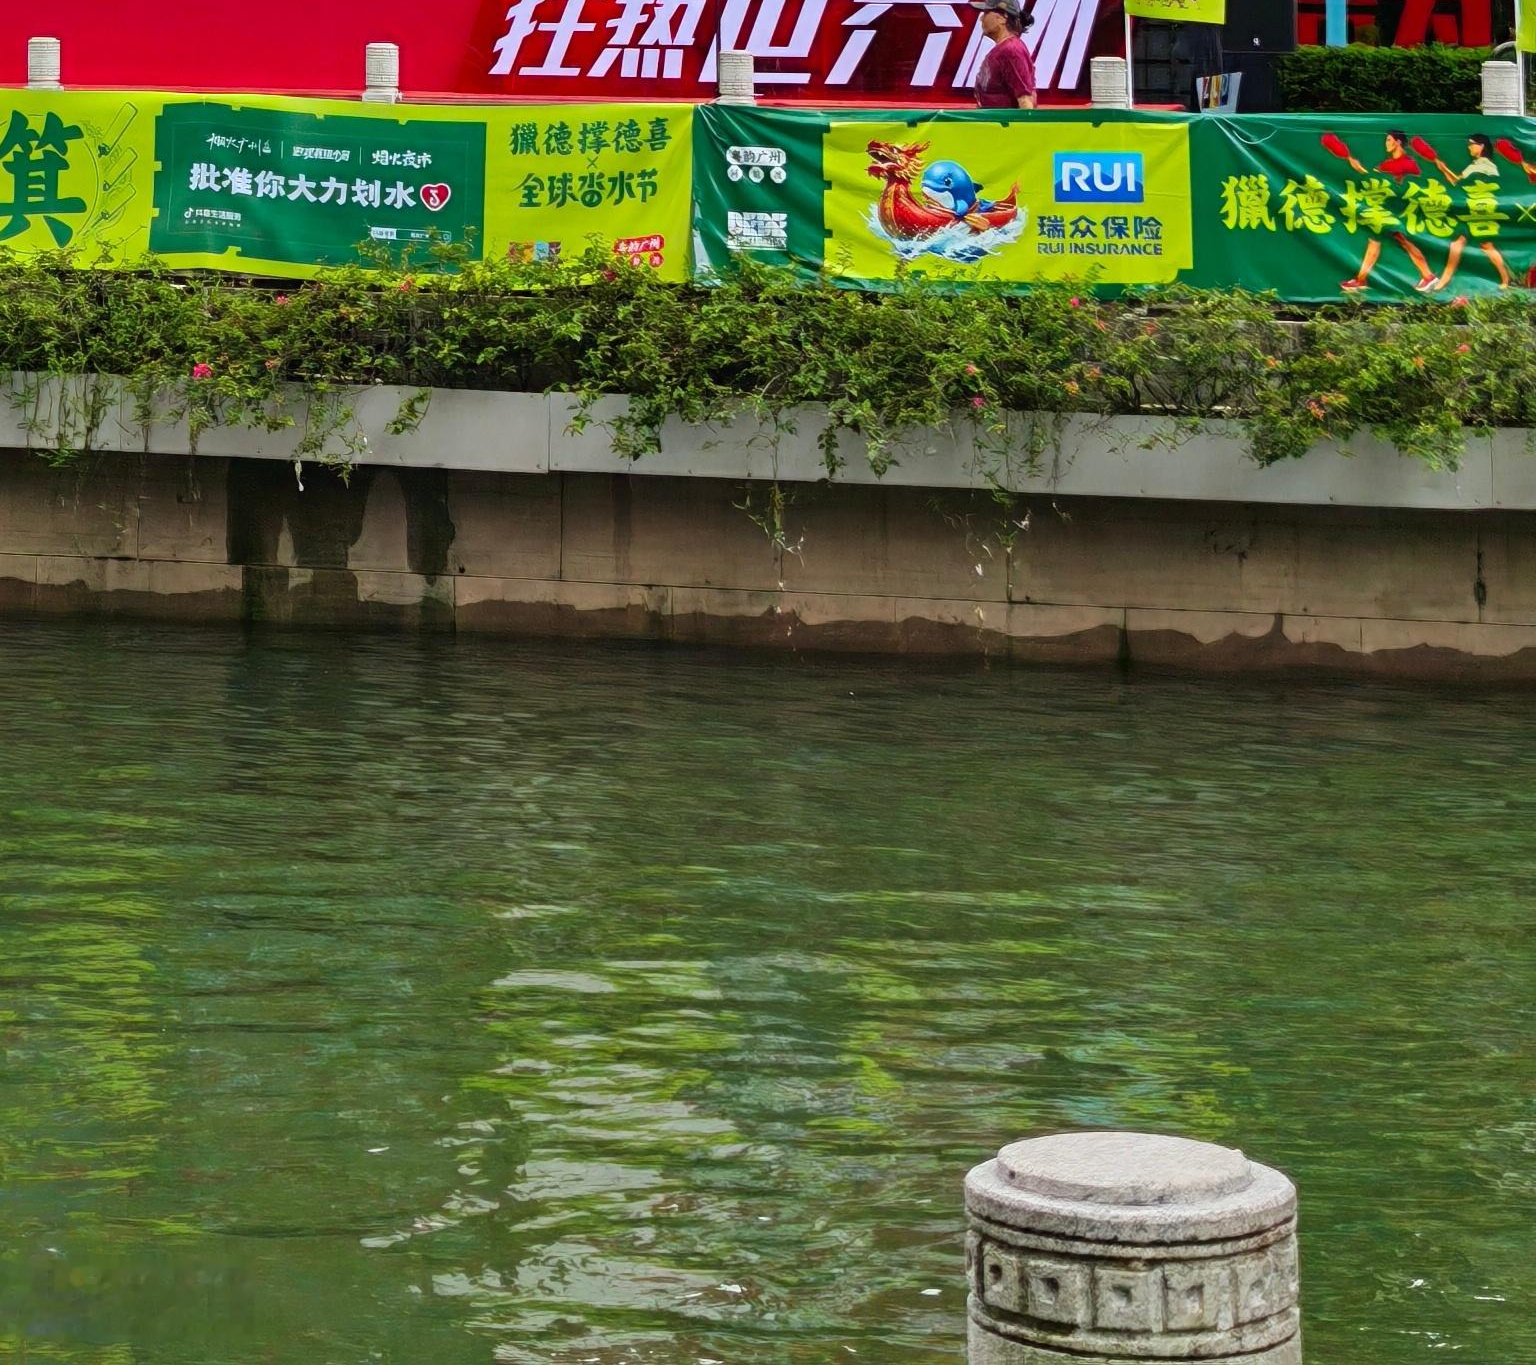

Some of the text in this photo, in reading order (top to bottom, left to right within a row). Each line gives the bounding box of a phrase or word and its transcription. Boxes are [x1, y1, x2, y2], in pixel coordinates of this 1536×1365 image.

[189, 163, 417, 209] 批准你大力划水
[1061, 161, 1136, 192] RUI
[1037, 215, 1163, 240] 瑞众保险
[1037, 243, 1163, 256] RUI INSURANCE
